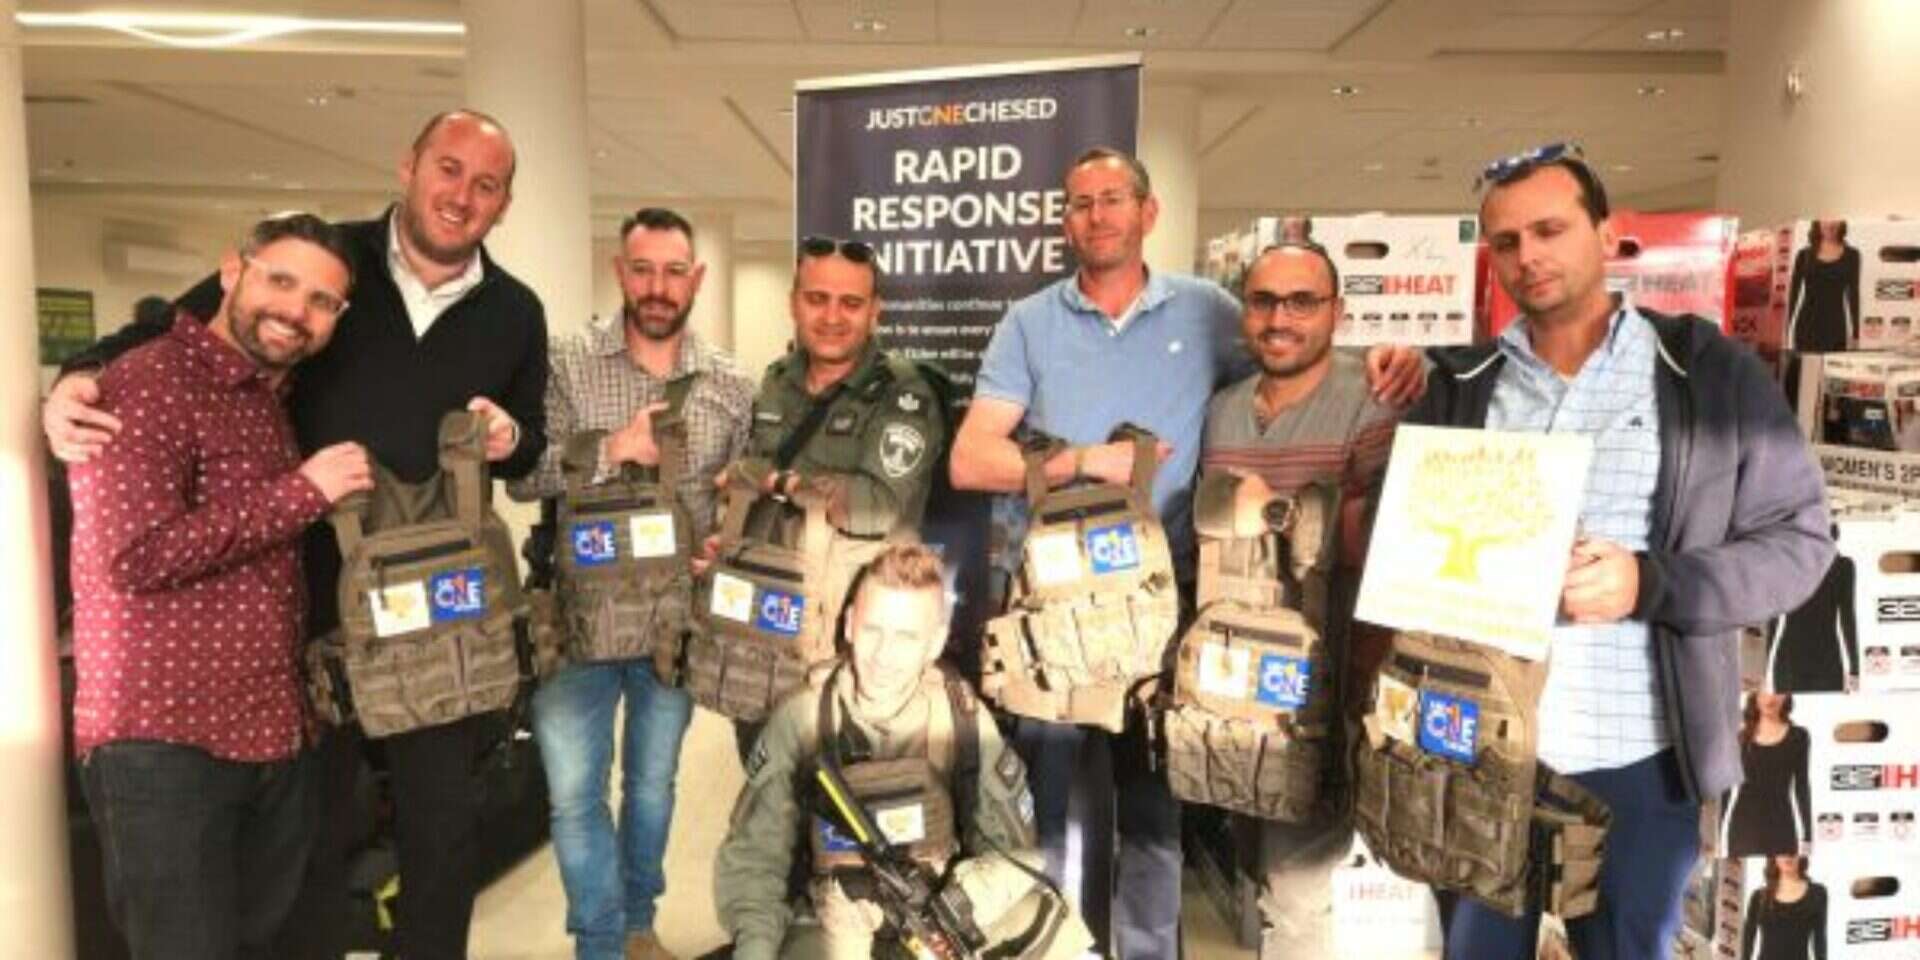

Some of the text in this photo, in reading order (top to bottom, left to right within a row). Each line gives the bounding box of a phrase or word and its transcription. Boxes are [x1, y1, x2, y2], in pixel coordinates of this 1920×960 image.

[894, 145, 1022, 184] RAPID
[853, 191, 1064, 231] RESPONSE
[868, 236, 1066, 275] NITIATIVE
[1820, 455, 1896, 480] WOMEN'S
